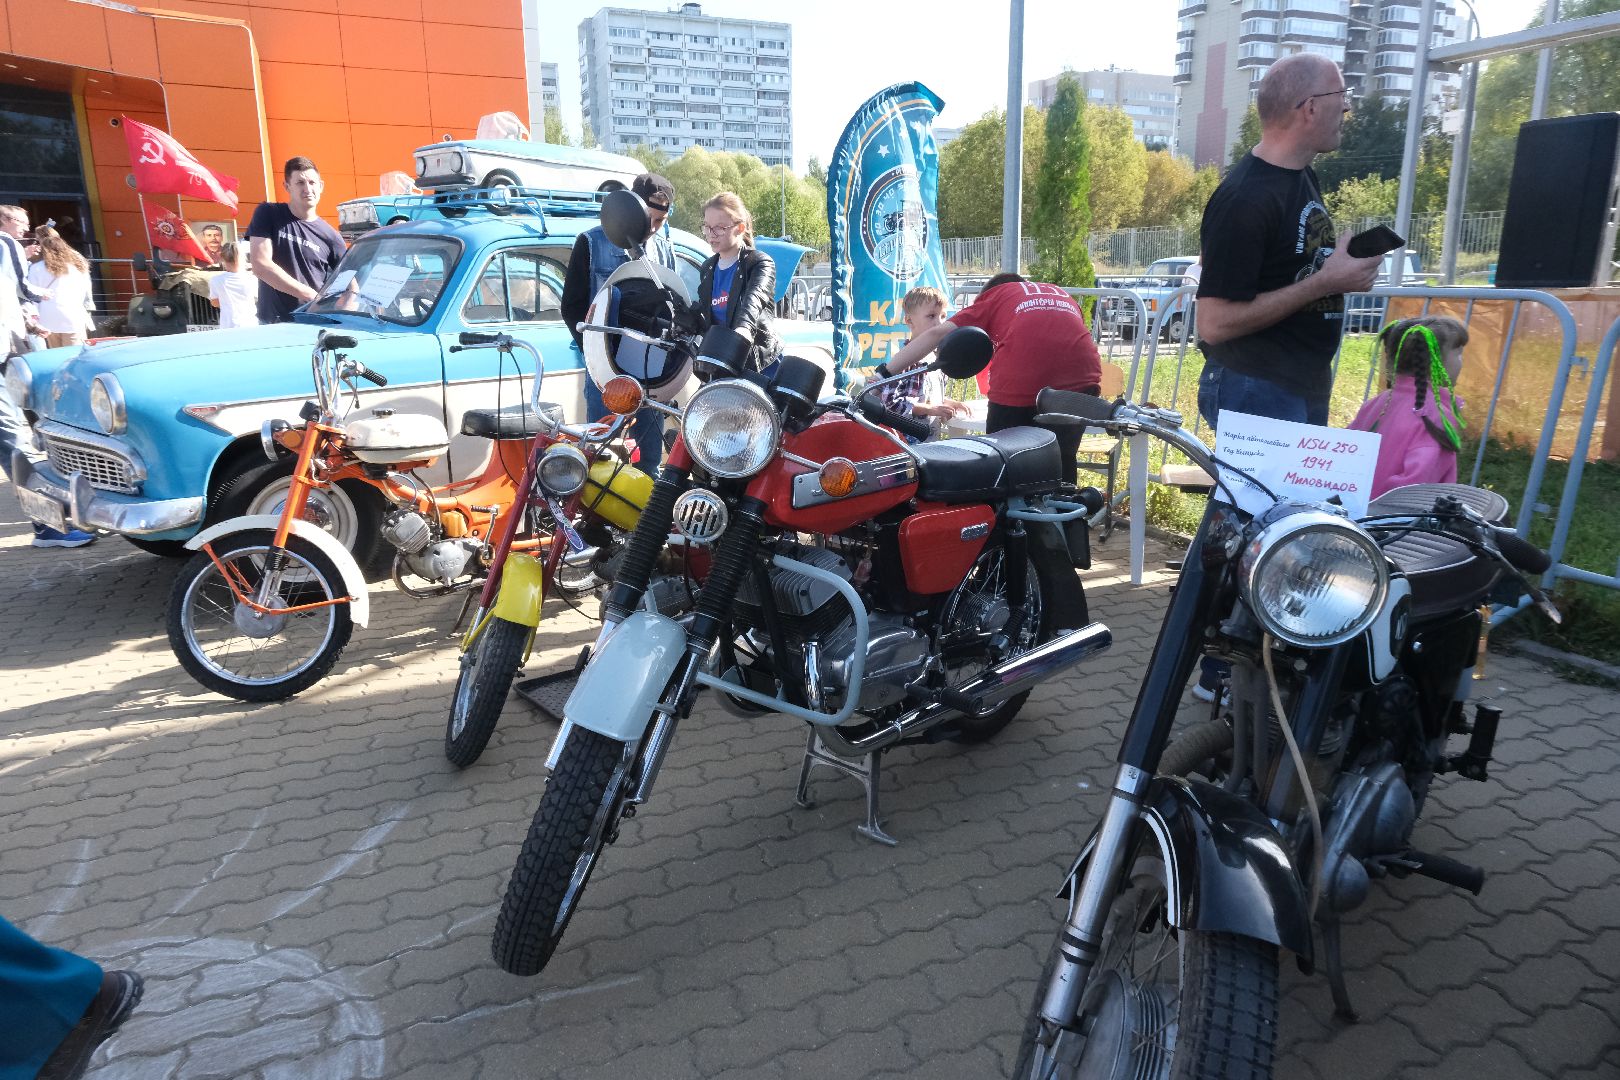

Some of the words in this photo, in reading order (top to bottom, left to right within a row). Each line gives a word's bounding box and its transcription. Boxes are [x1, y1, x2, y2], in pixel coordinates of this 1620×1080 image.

[1297, 437, 1331, 451] NSU
[1332, 442, 1359, 454] 250
[1301, 456, 1334, 471] 1941
